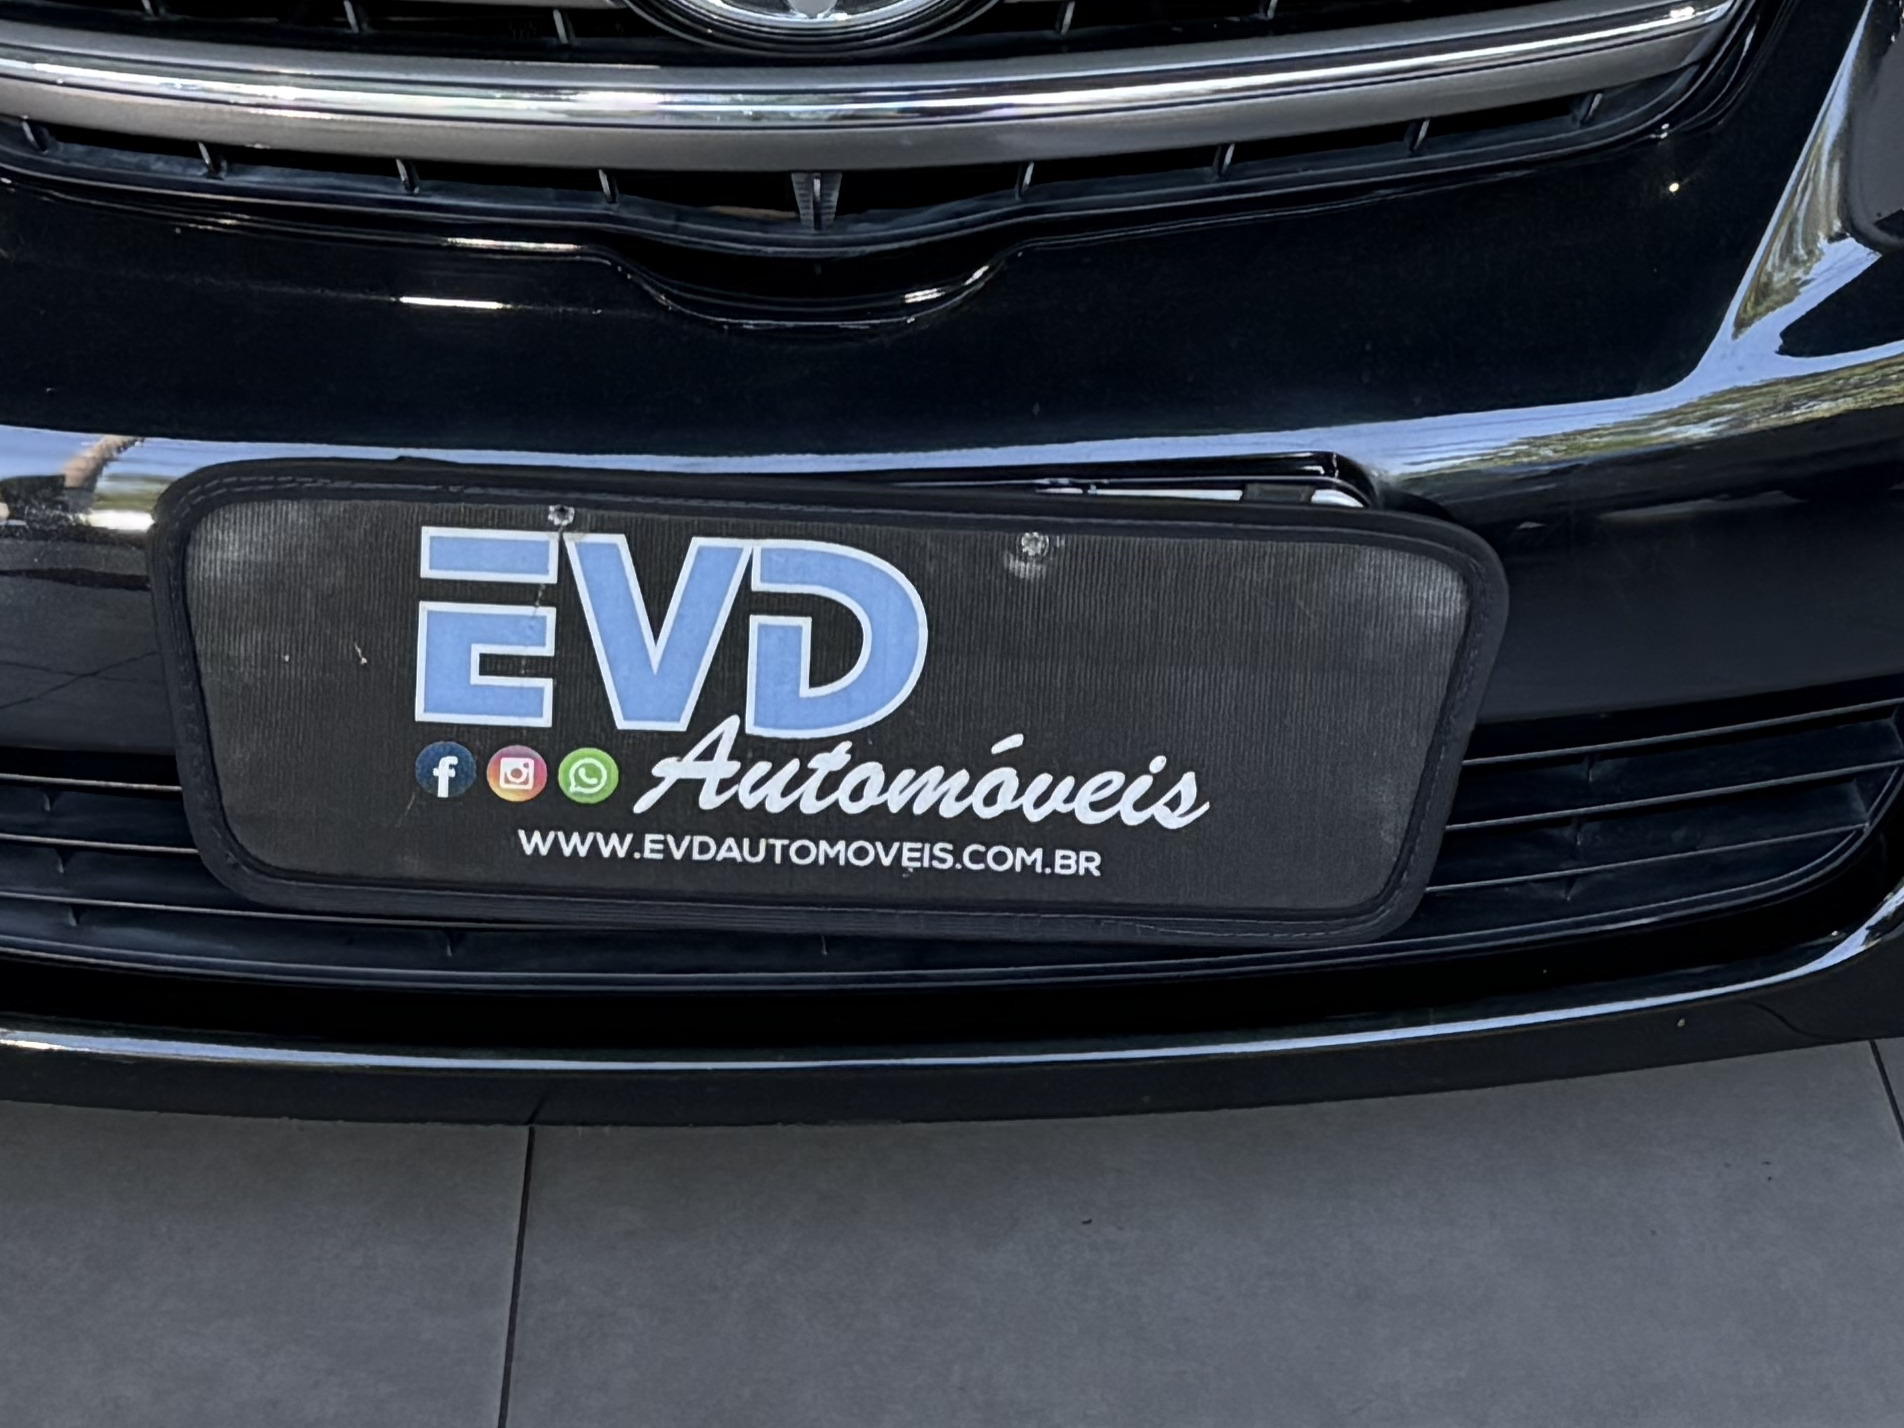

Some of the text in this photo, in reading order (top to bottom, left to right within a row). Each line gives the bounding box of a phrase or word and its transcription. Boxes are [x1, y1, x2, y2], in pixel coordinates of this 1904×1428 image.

[415, 526, 929, 739] EVD
[632, 714, 1210, 830] Automóveis
[517, 828, 1102, 877] WWW.EVDAUTOMOVEIS.COM.BR
